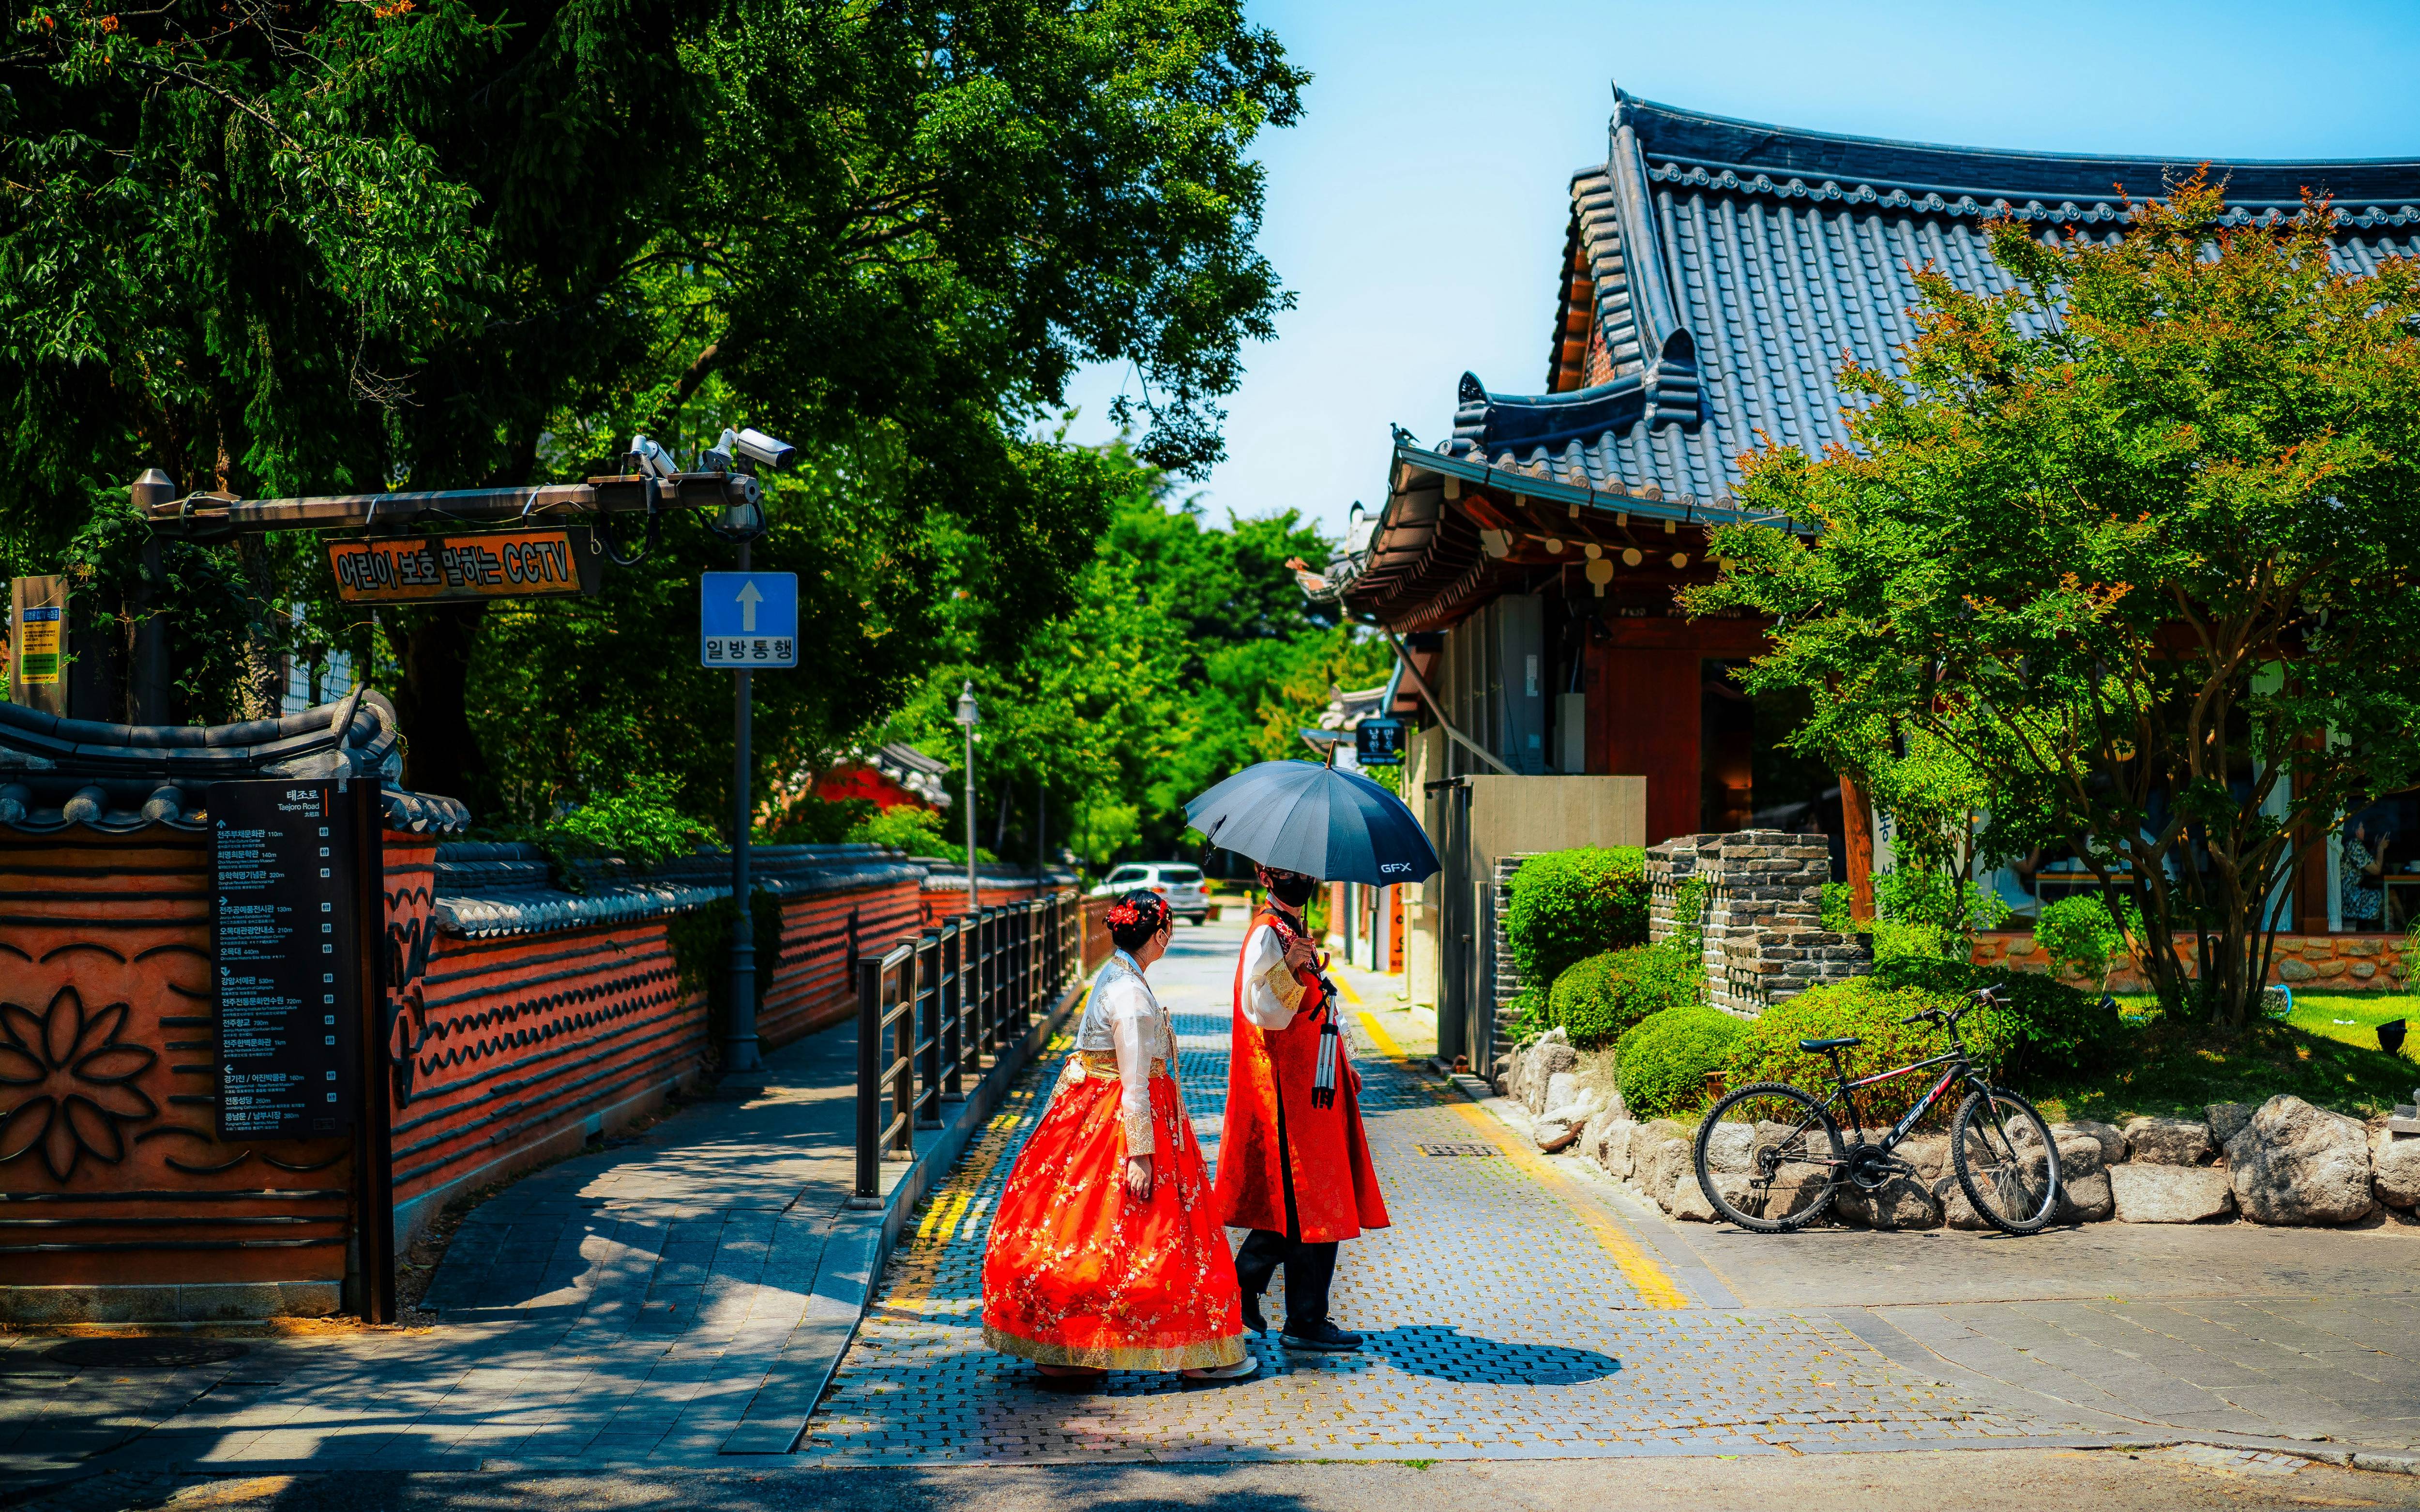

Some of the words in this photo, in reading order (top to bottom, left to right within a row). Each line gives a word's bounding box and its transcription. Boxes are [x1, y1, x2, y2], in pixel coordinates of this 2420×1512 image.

[337, 551, 397, 590] 어린이
[397, 549, 441, 586] 보호
[441, 545, 503, 587] 말하는
[503, 540, 568, 585] CCTV
[707, 640, 792, 660] 일방통행
[286, 789, 319, 802] 태조로
[277, 803, 302, 812] Taejoro
[217, 830, 266, 839] 전주부채문화관
[217, 850, 258, 859] 최명희문학관
[1380, 862, 1412, 873] GFX
[218, 871, 267, 880] 동학혁명기념관
[219, 905, 274, 914] 전주공예품전시관
[219, 926, 275, 935] 오목대관광안내소
[220, 947, 241, 955] 오목대
[221, 977, 256, 985] 강암서예관
[222, 997, 284, 1006] 전주전통문화연수원
[223, 1019, 251, 1027] 전주향교
[223, 1038, 272, 1047] 전주한벽문화관
[224, 1074, 245, 1083] 경기전
[252, 1073, 287, 1082] 어진박물관
[225, 1096, 253, 1105] 전동성당
[225, 1112, 246, 1121] 풍남문
[253, 1111, 281, 1120] 남부시장
